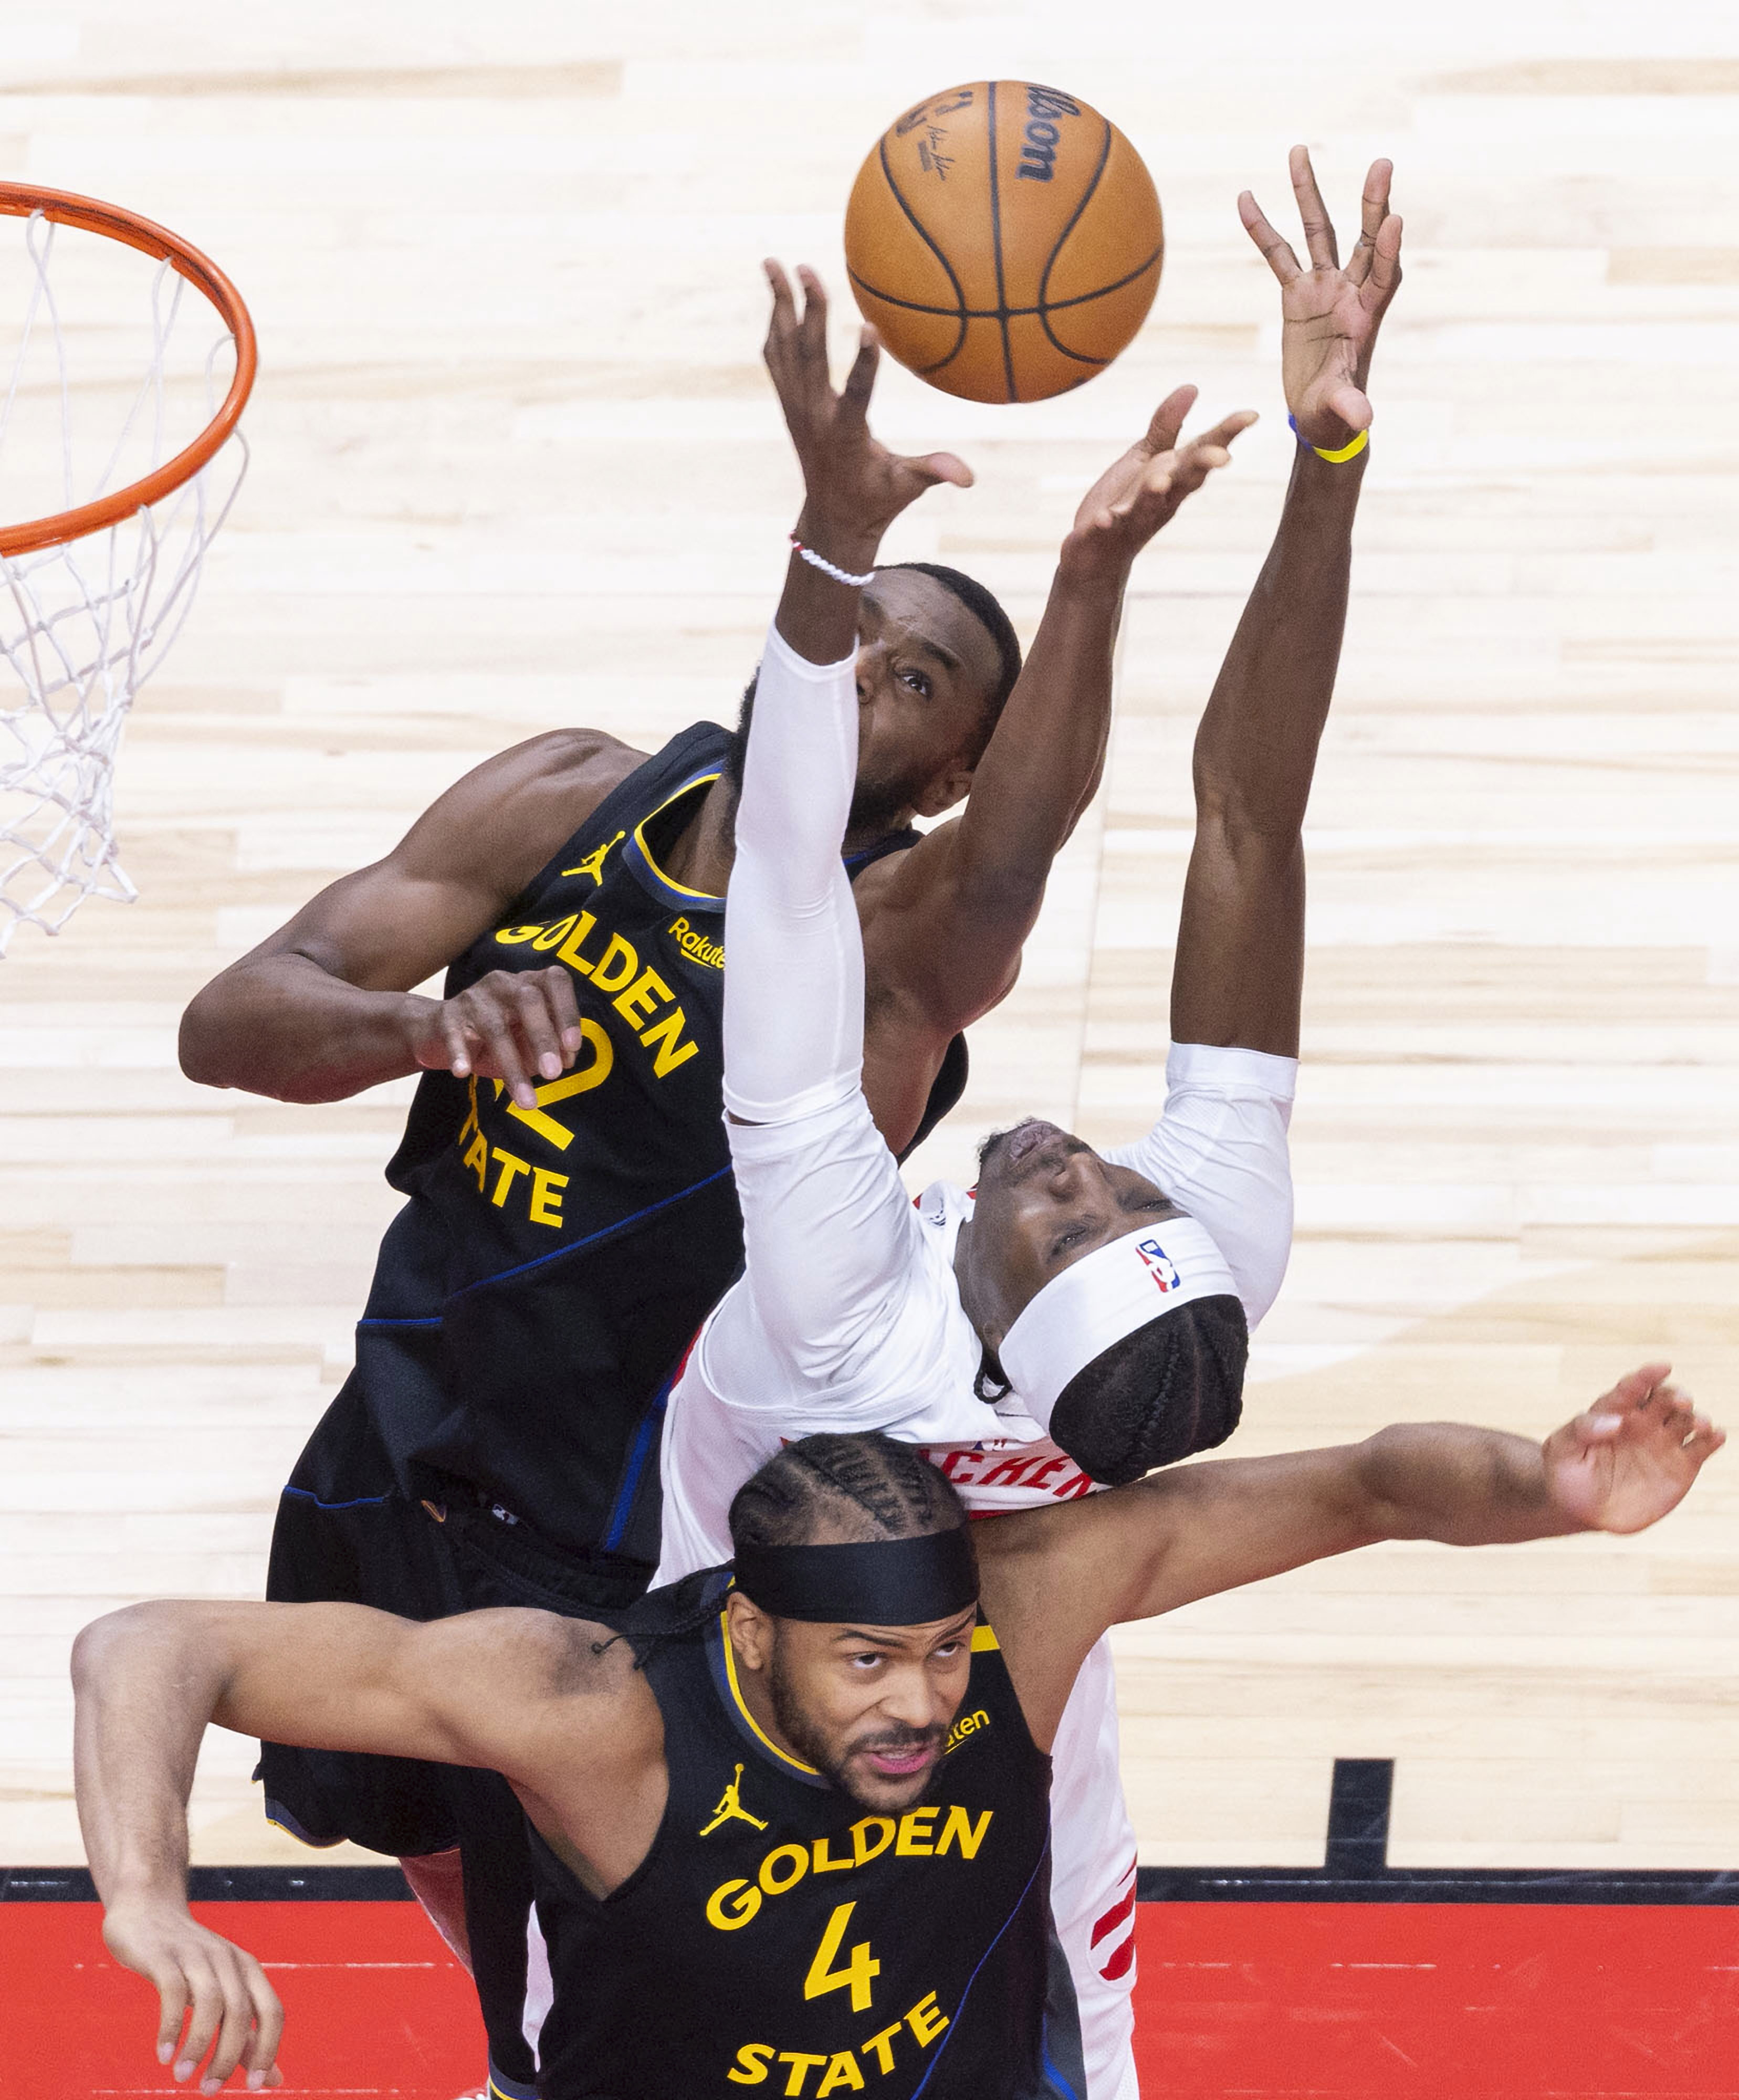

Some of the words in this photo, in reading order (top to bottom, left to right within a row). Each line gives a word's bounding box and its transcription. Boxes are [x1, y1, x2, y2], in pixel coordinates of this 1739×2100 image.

[495, 910, 699, 1078] GOLDEN
[668, 917, 726, 971] Rakute
[706, 1805, 993, 1931] GOLDEN
[804, 1901, 880, 2013] 4
[727, 1990, 950, 2099] STATE
